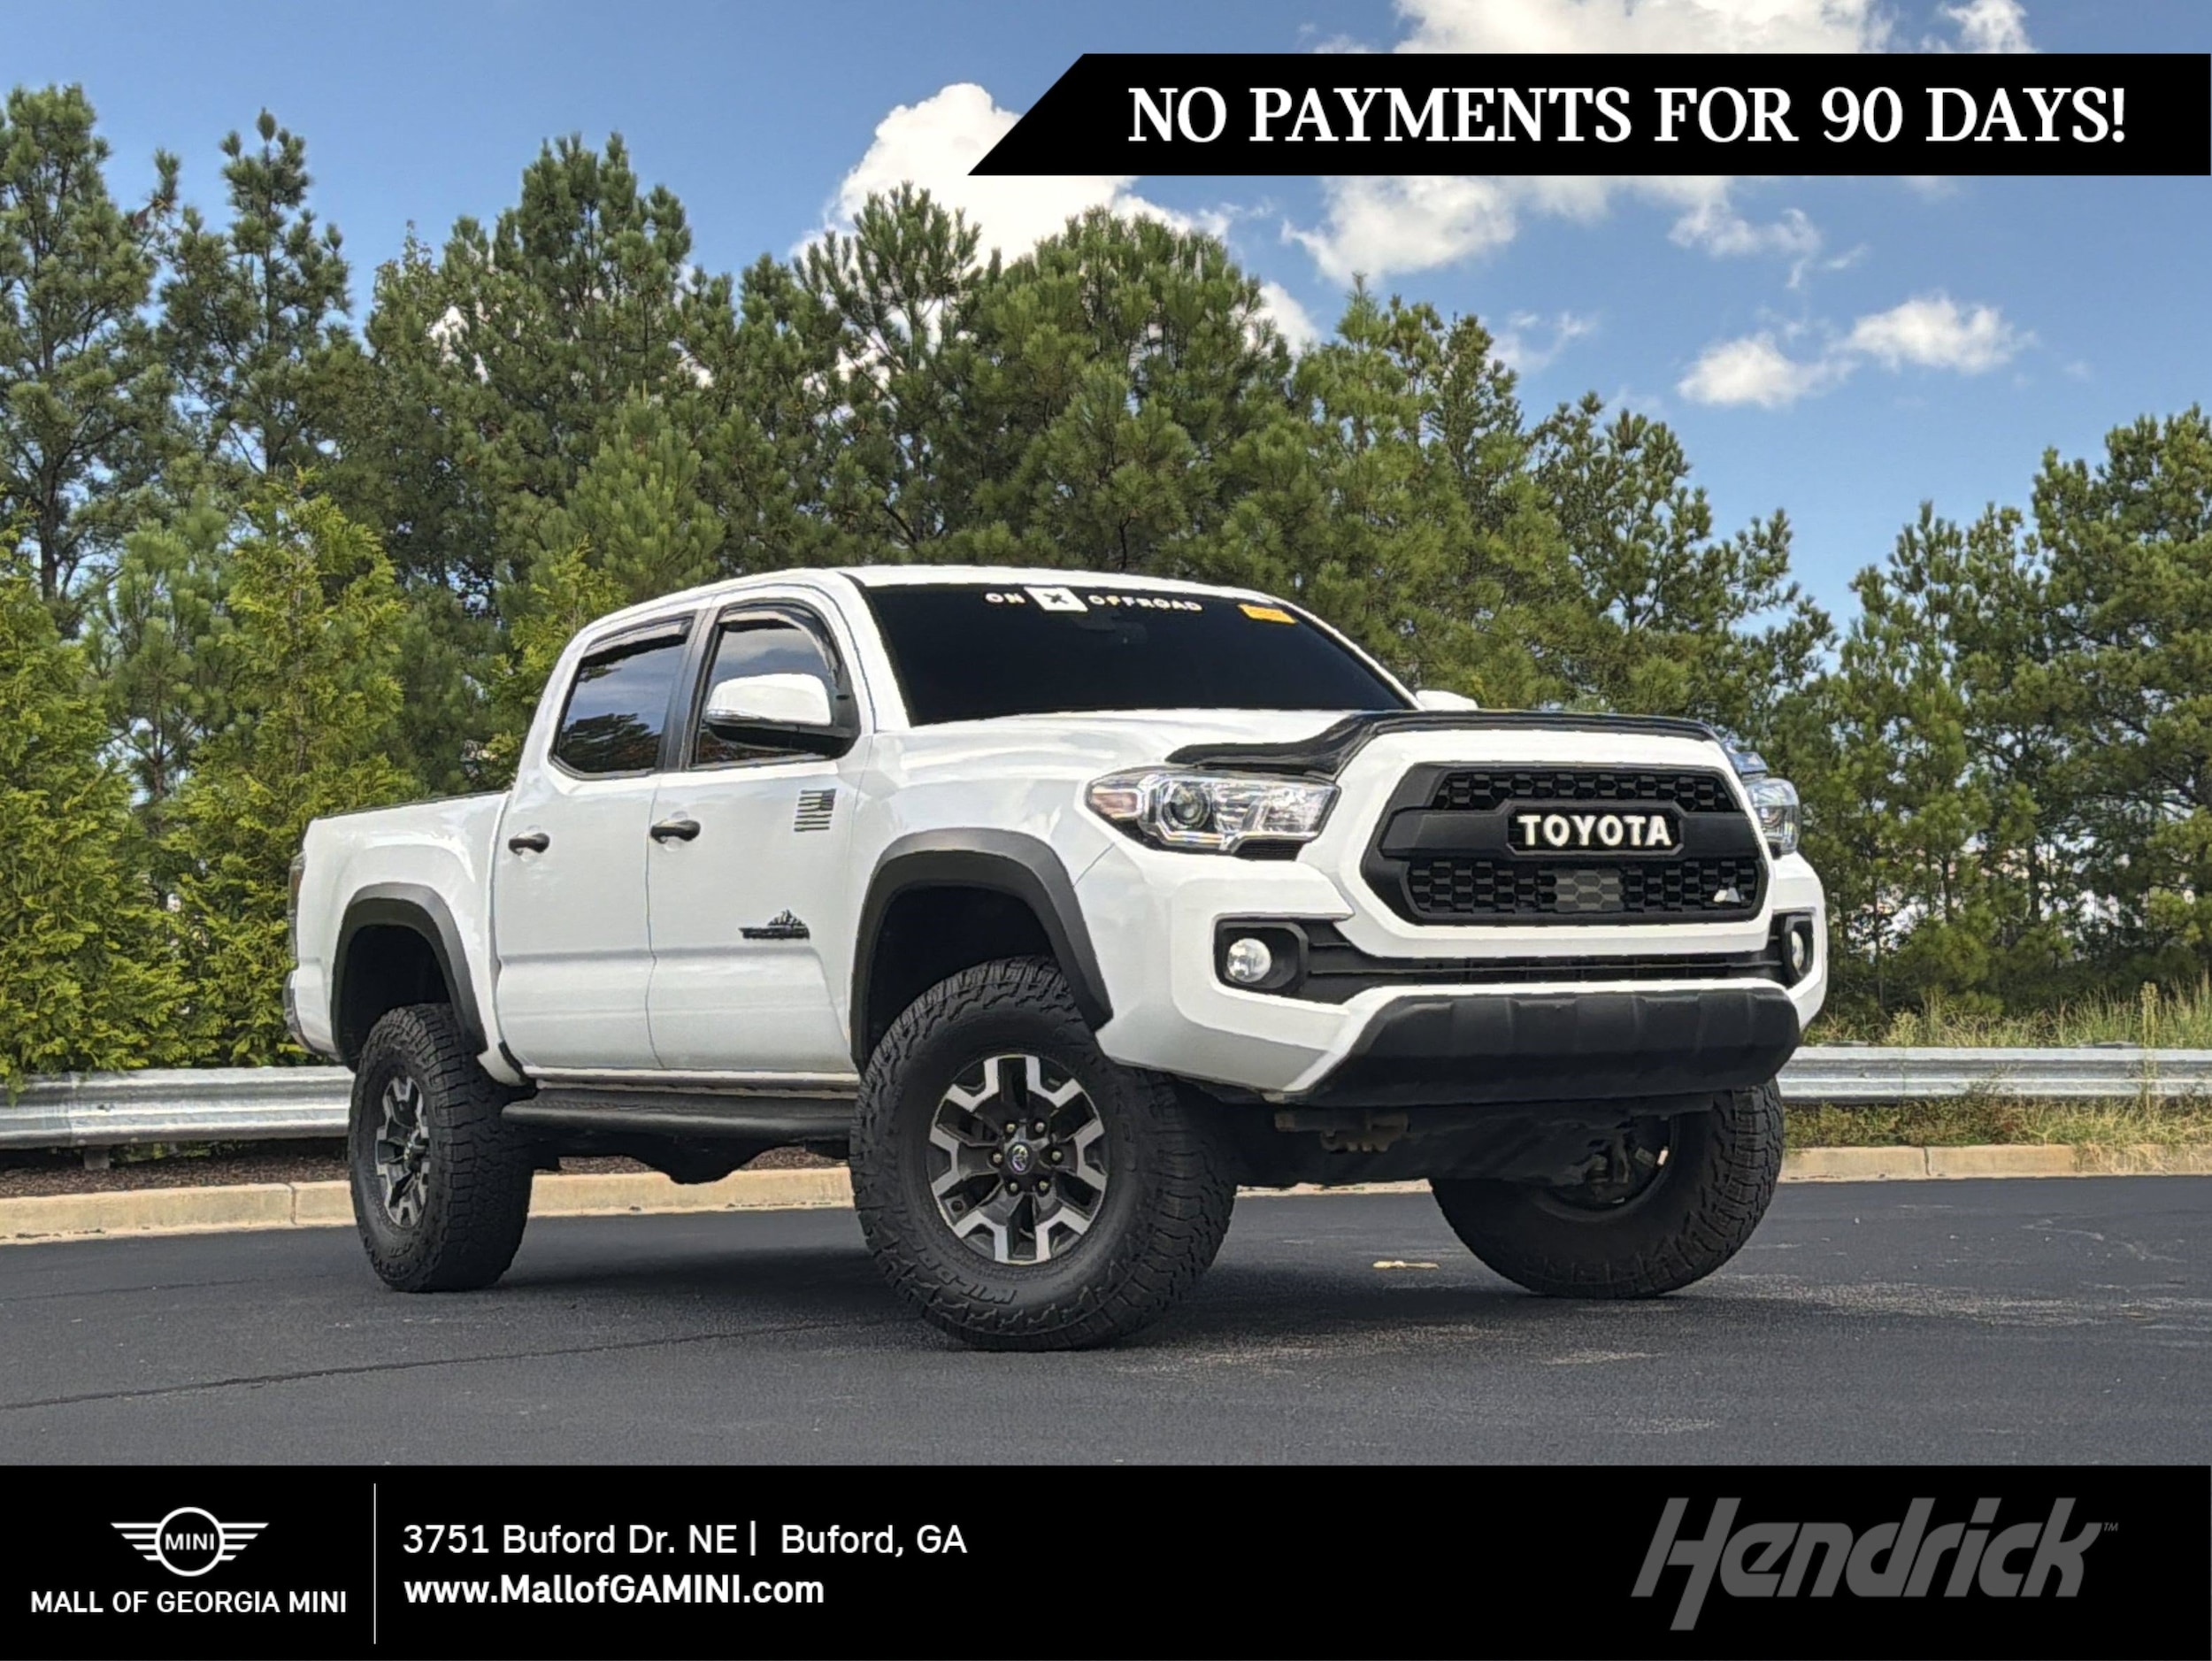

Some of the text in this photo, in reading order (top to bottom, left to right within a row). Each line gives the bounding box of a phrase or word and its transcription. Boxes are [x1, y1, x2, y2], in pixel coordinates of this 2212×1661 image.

[985, 592, 1026, 604] ON
[1087, 594, 1203, 611] OFFROAD
[1517, 813, 1672, 847] TOYOTA
